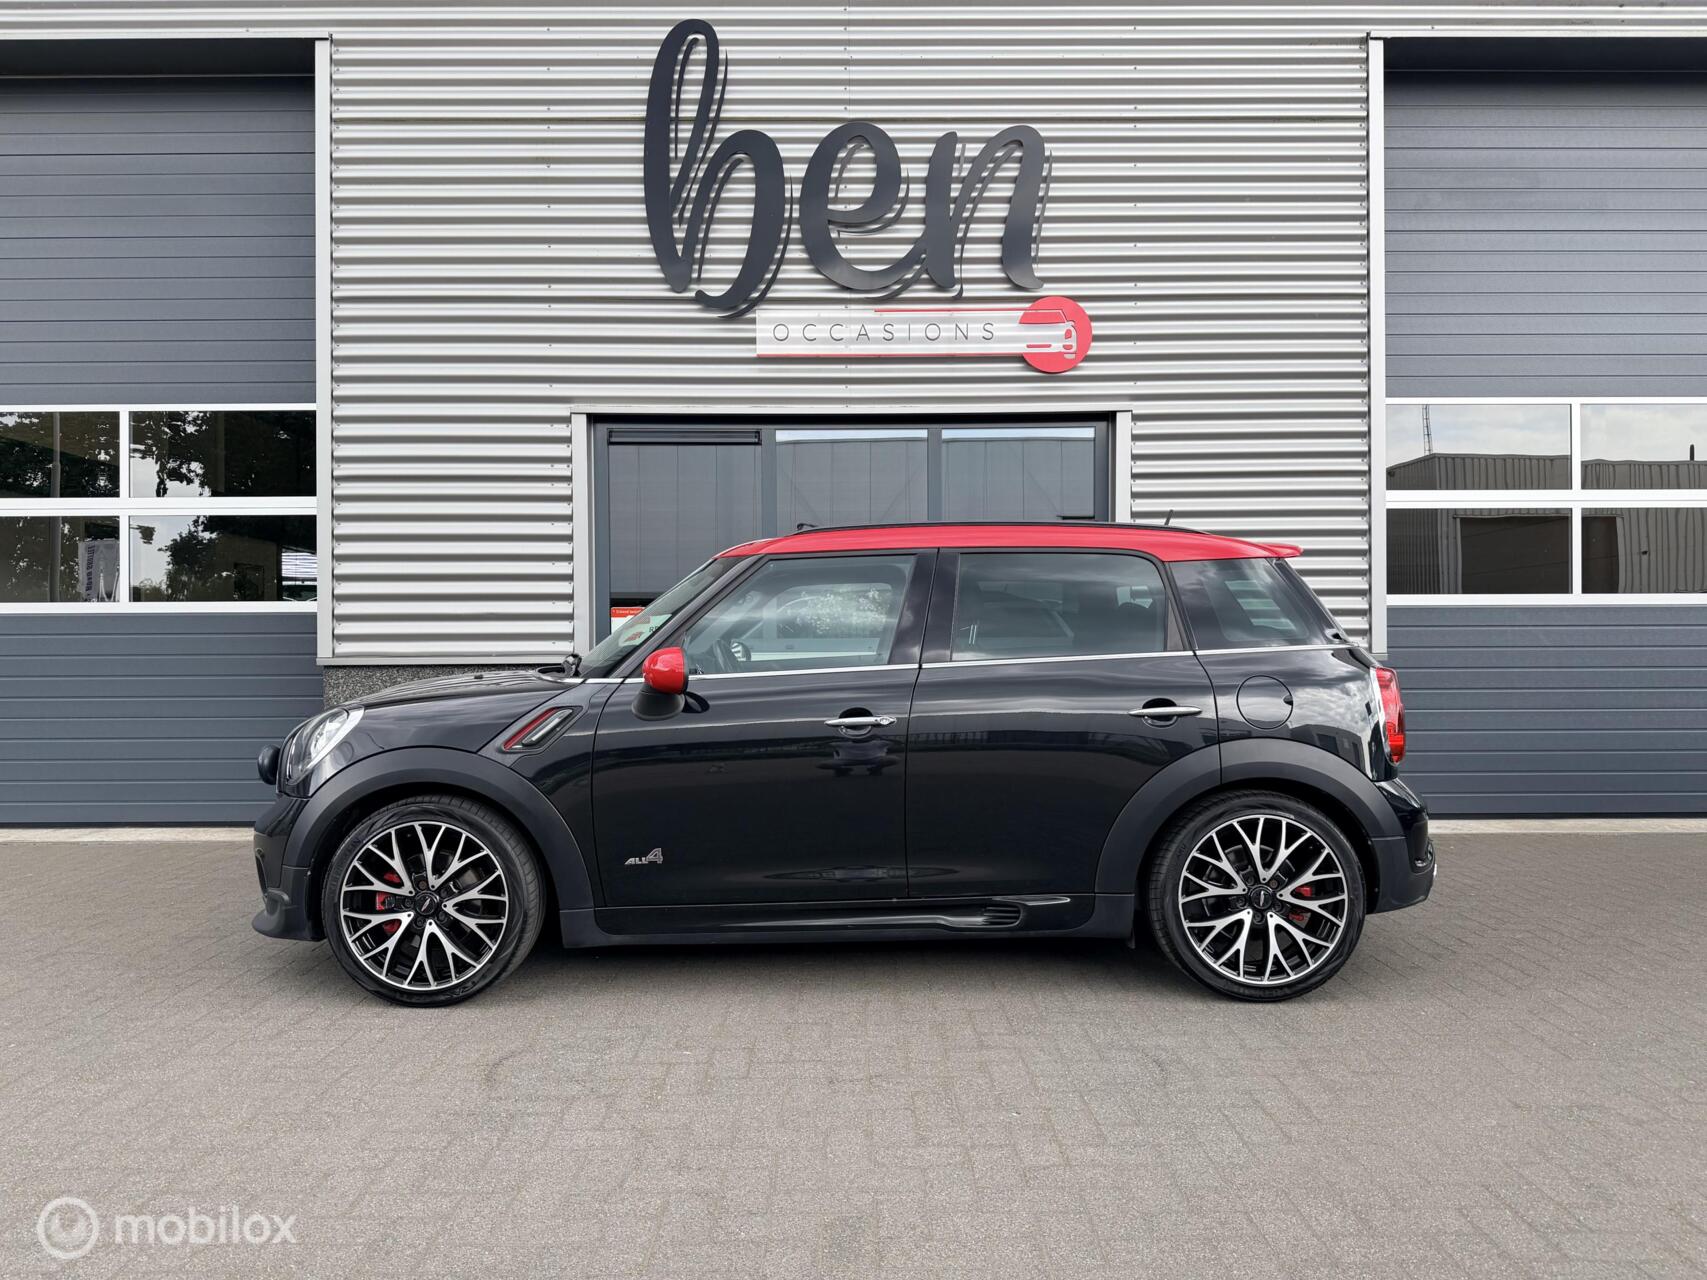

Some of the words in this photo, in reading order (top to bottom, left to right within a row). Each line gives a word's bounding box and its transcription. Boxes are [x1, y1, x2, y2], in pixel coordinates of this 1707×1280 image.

[644, 19, 1053, 318] ben
[772, 322, 995, 343] OCCASIONS
[624, 847, 663, 865] ALL4
